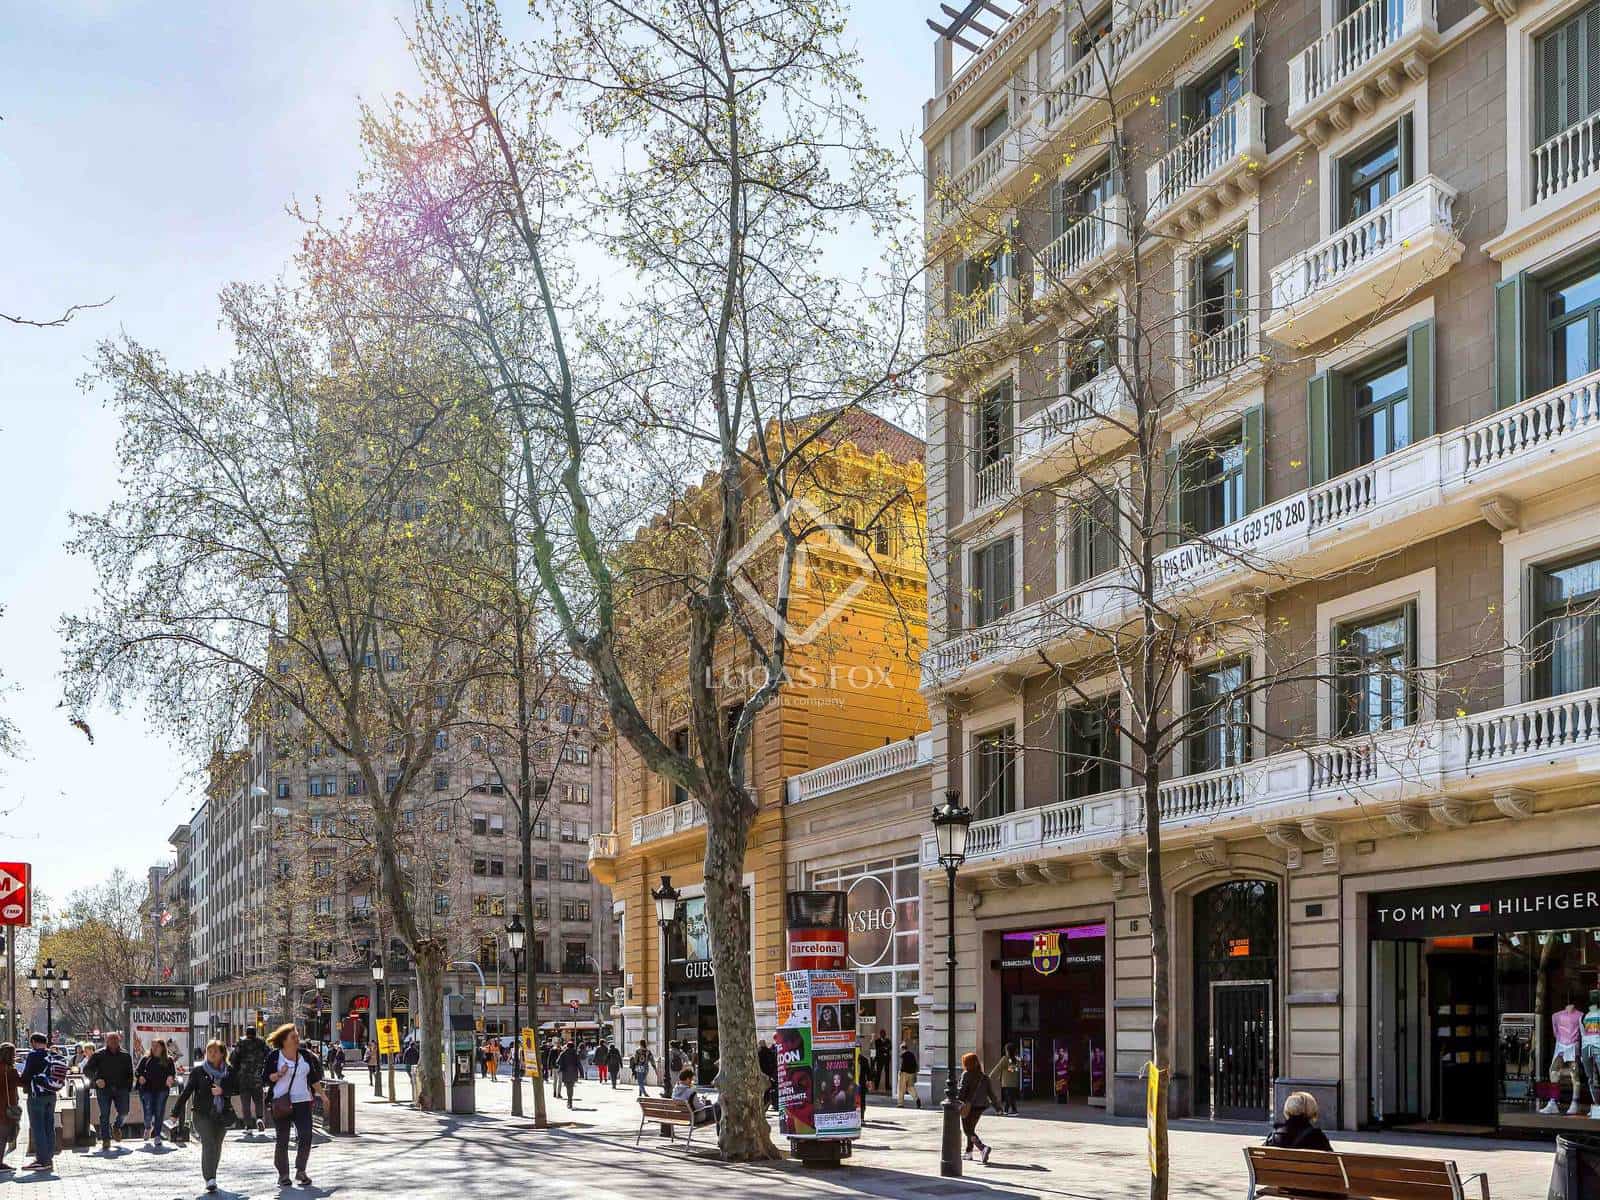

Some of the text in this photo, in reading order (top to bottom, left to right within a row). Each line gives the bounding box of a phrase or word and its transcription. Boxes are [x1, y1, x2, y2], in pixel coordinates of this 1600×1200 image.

[1164, 555, 1179, 577] PIS
[1180, 549, 1194, 572] EN
[1243, 519, 1261, 545] 639
[1263, 509, 1282, 536] 578
[1285, 500, 1305, 528] 280
[1378, 891, 1600, 923] TOMMY HILFIGER
[848, 907, 896, 933] YSHO
[1129, 920, 1139, 932] 15
[791, 943, 837, 953] Barcelona
[686, 961, 714, 978] GUES
